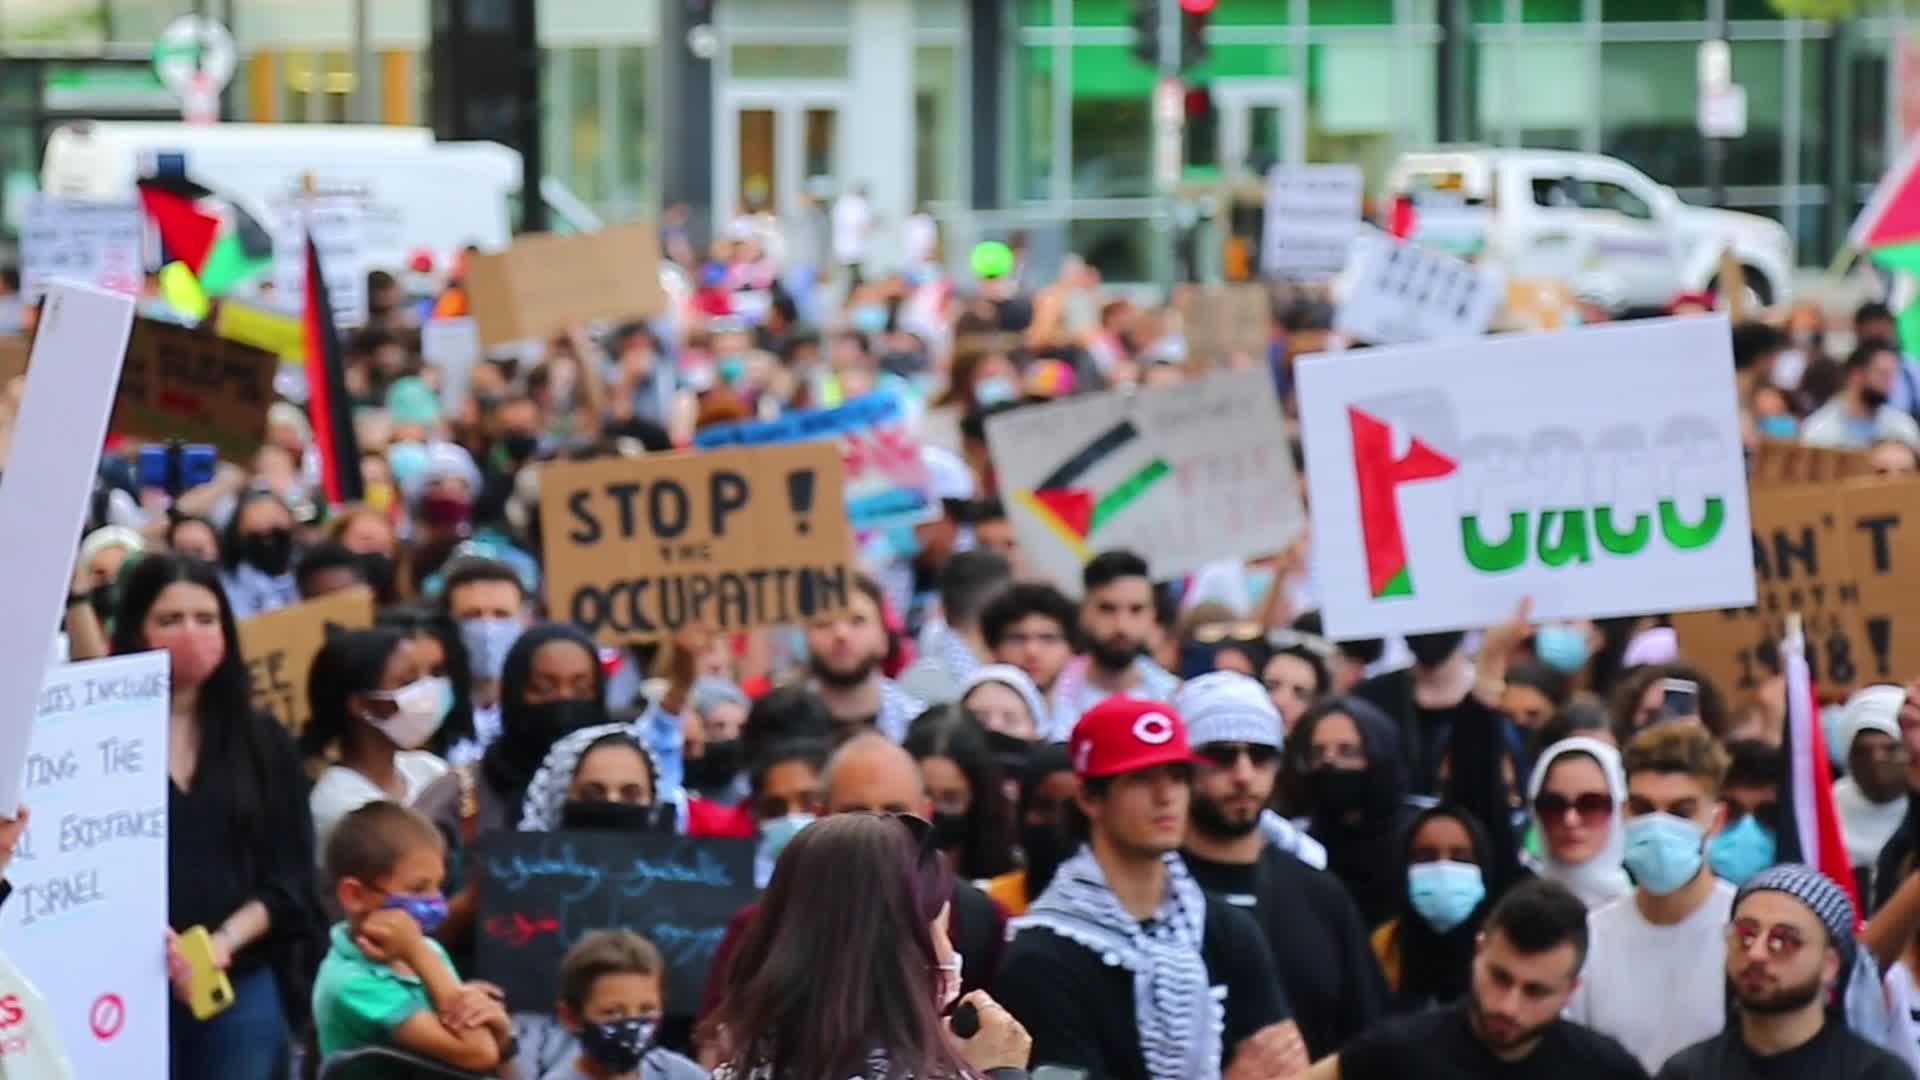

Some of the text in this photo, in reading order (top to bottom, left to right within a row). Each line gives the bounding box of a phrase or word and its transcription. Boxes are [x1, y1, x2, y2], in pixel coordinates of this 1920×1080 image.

[567, 469, 749, 545] STOP
[1131, 711, 1175, 745] C
[98, 736, 145, 777] THE
[16, 867, 105, 926] ISRAEL
